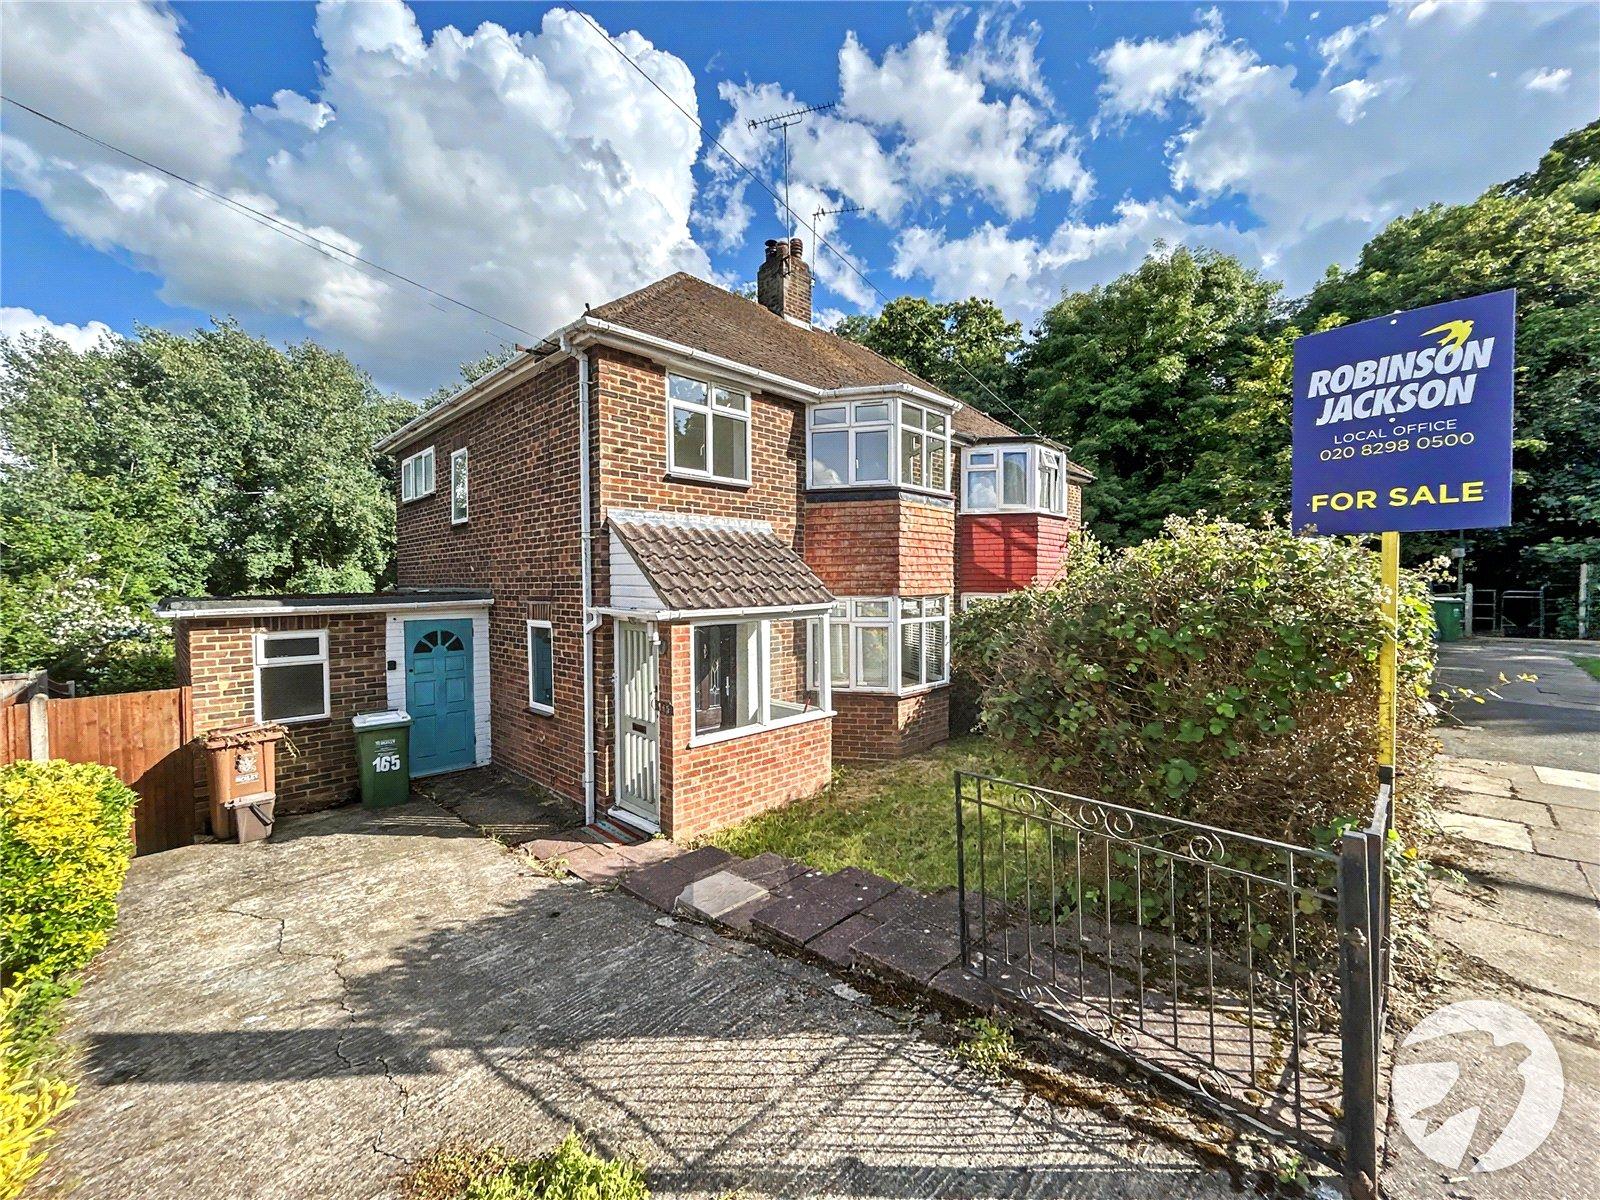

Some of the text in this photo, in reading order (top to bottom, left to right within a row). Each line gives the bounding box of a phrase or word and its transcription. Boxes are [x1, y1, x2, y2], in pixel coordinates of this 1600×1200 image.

[1308, 337, 1495, 399] ROBINSON
[1316, 374, 1477, 426] JACKSON
[1320, 432, 1475, 462] 020 8298 0500
[1334, 418, 1458, 445] LOCAL OFFICE
[1311, 481, 1484, 513] FOR SALE
[372, 754, 401, 773] 165
